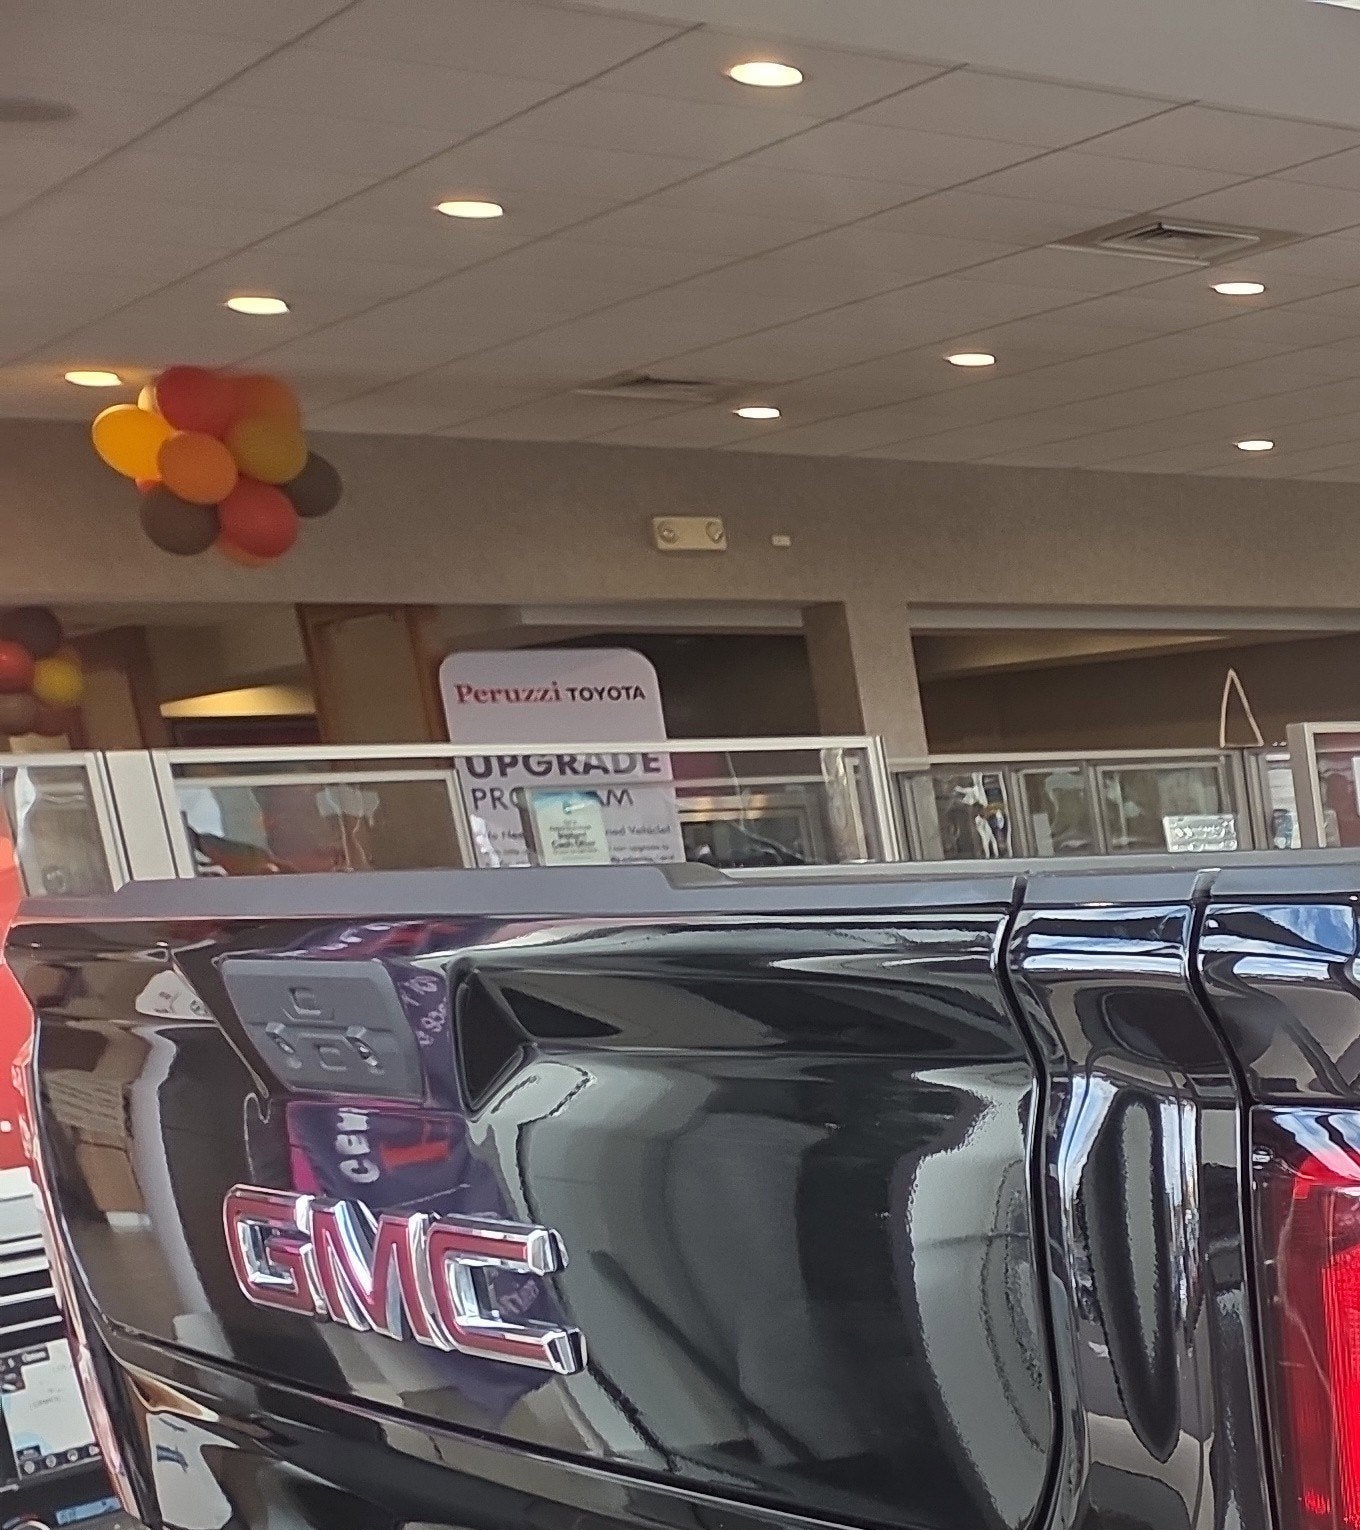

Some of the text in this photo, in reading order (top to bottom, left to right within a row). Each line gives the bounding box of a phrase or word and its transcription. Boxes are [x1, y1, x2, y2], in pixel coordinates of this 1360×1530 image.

[454, 680, 647, 705] Peruzzi TOYOTA
[465, 752, 663, 780] UPGRADE
[223, 1184, 589, 1375] GMC
